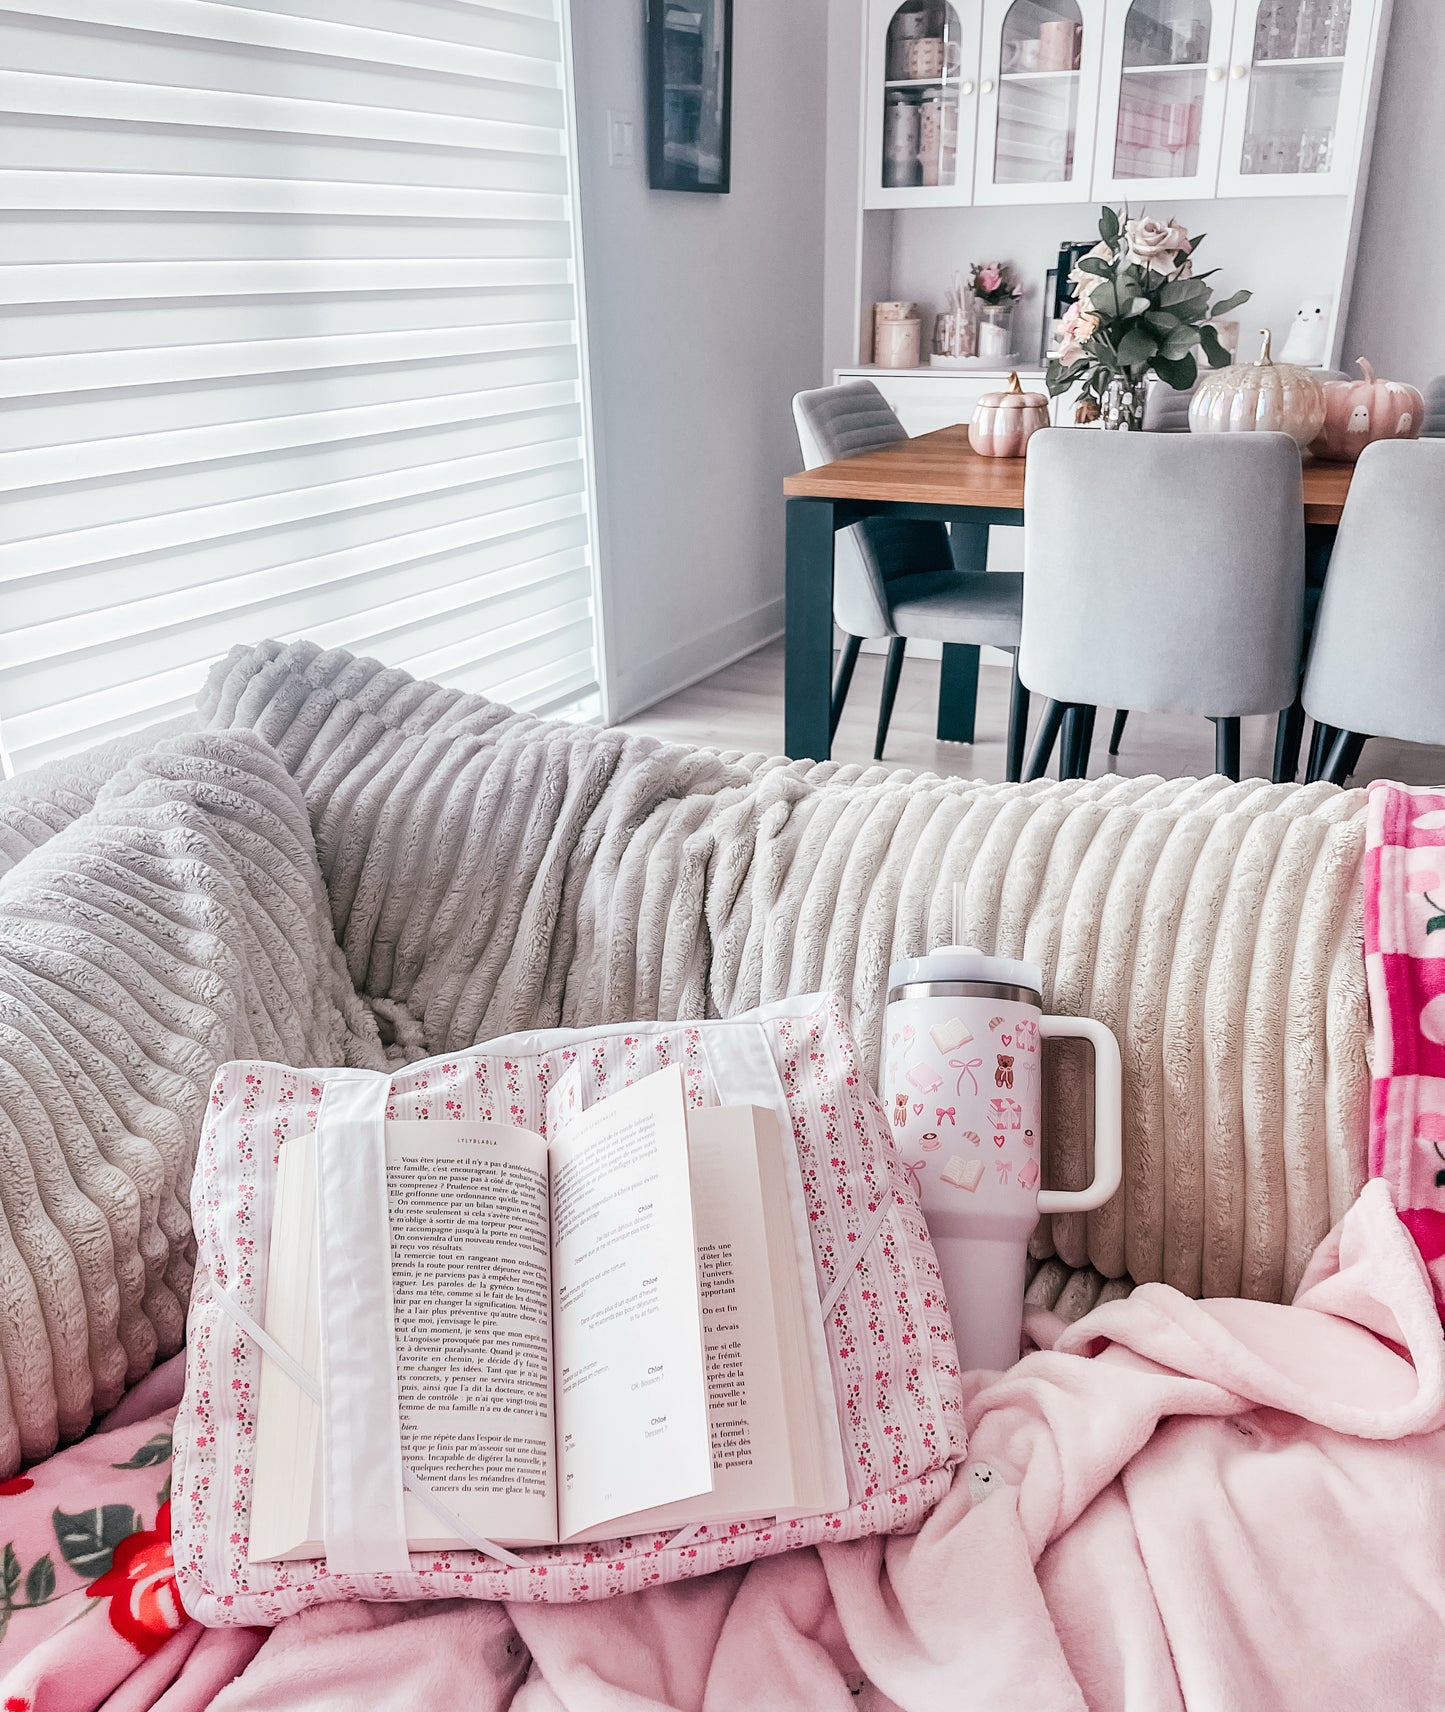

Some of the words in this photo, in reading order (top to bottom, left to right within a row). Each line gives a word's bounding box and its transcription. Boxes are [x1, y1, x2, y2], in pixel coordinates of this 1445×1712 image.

[404, 1164, 430, 1172] famille,
[446, 1182, 478, 1191] Prudence
[405, 1190, 438, 1198] griffonne
[456, 1191, 496, 1200] ordonnance
[476, 1201, 493, 1209] bilan
[496, 1204, 521, 1213] sanguin
[481, 1220, 505, 1228] torpeur
[406, 1226, 452, 1234] raccompagne
[493, 1264, 521, 1274] déjeuner
[716, 1261, 733, 1269] plier.
[435, 1271, 465, 1279] parviens
[488, 1274, 520, 1282] empêcher
[438, 1280, 464, 1289] paroles
[434, 1298, 462, 1307] changer
[474, 1300, 517, 1310] signification.
[432, 1307, 447, 1316] plus
[450, 1308, 487, 1317] préventive
[442, 1337, 480, 1345] provoquée
[445, 1346, 487, 1355] paralysante.
[445, 1355, 474, 1364] chemin,
[488, 1357, 510, 1365] décide
[418, 1364, 446, 1373] changer
[402, 1384, 419, 1393] puis,
[495, 1386, 526, 1396] docteure,
[710, 1390, 740, 1399] nouvelle
[716, 1418, 749, 1428] terminés,
[720, 1428, 744, 1438] formel
[434, 1434, 456, 1443] répète
[737, 1449, 751, 1458] plus
[429, 1454, 464, 1463] Incapable
[478, 1454, 503, 1463] digérer
[410, 1464, 443, 1473] quelques
[726, 1460, 752, 1469] passera
[505, 1486, 522, 1494] glace
